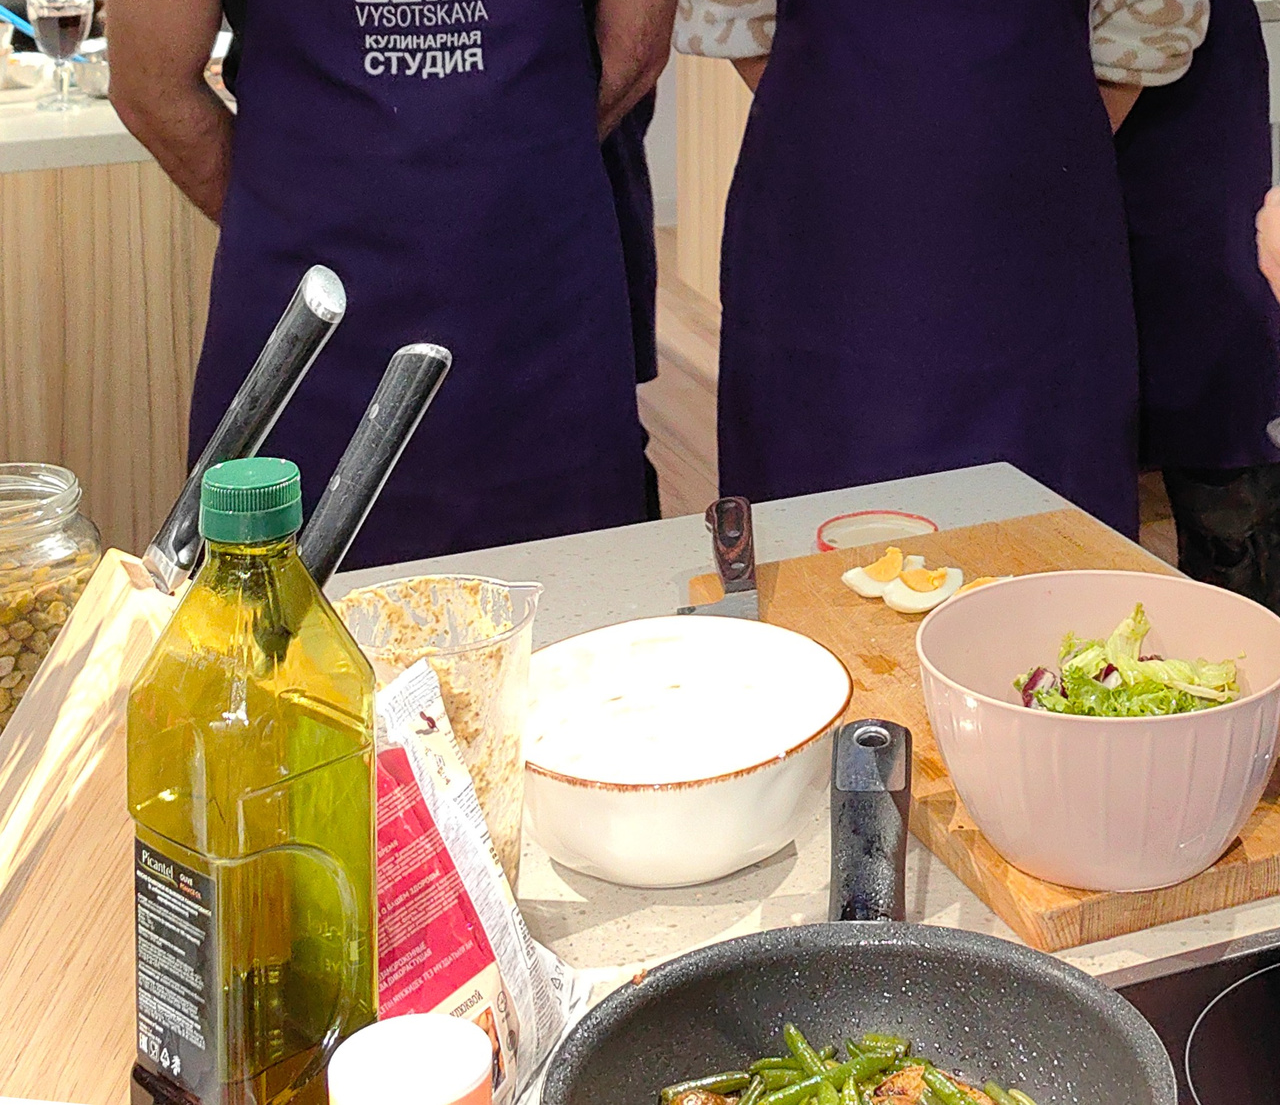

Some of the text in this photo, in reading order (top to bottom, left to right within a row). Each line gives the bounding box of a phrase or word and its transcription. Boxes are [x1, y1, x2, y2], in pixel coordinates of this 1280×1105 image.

[355, 0, 489, 27] VYSOTSKAYA
[365, 30, 482, 49] КУЛИНАРНАЯ
[364, 47, 484, 79] СТУДИЯ
[142, 849, 174, 879] Picantel
